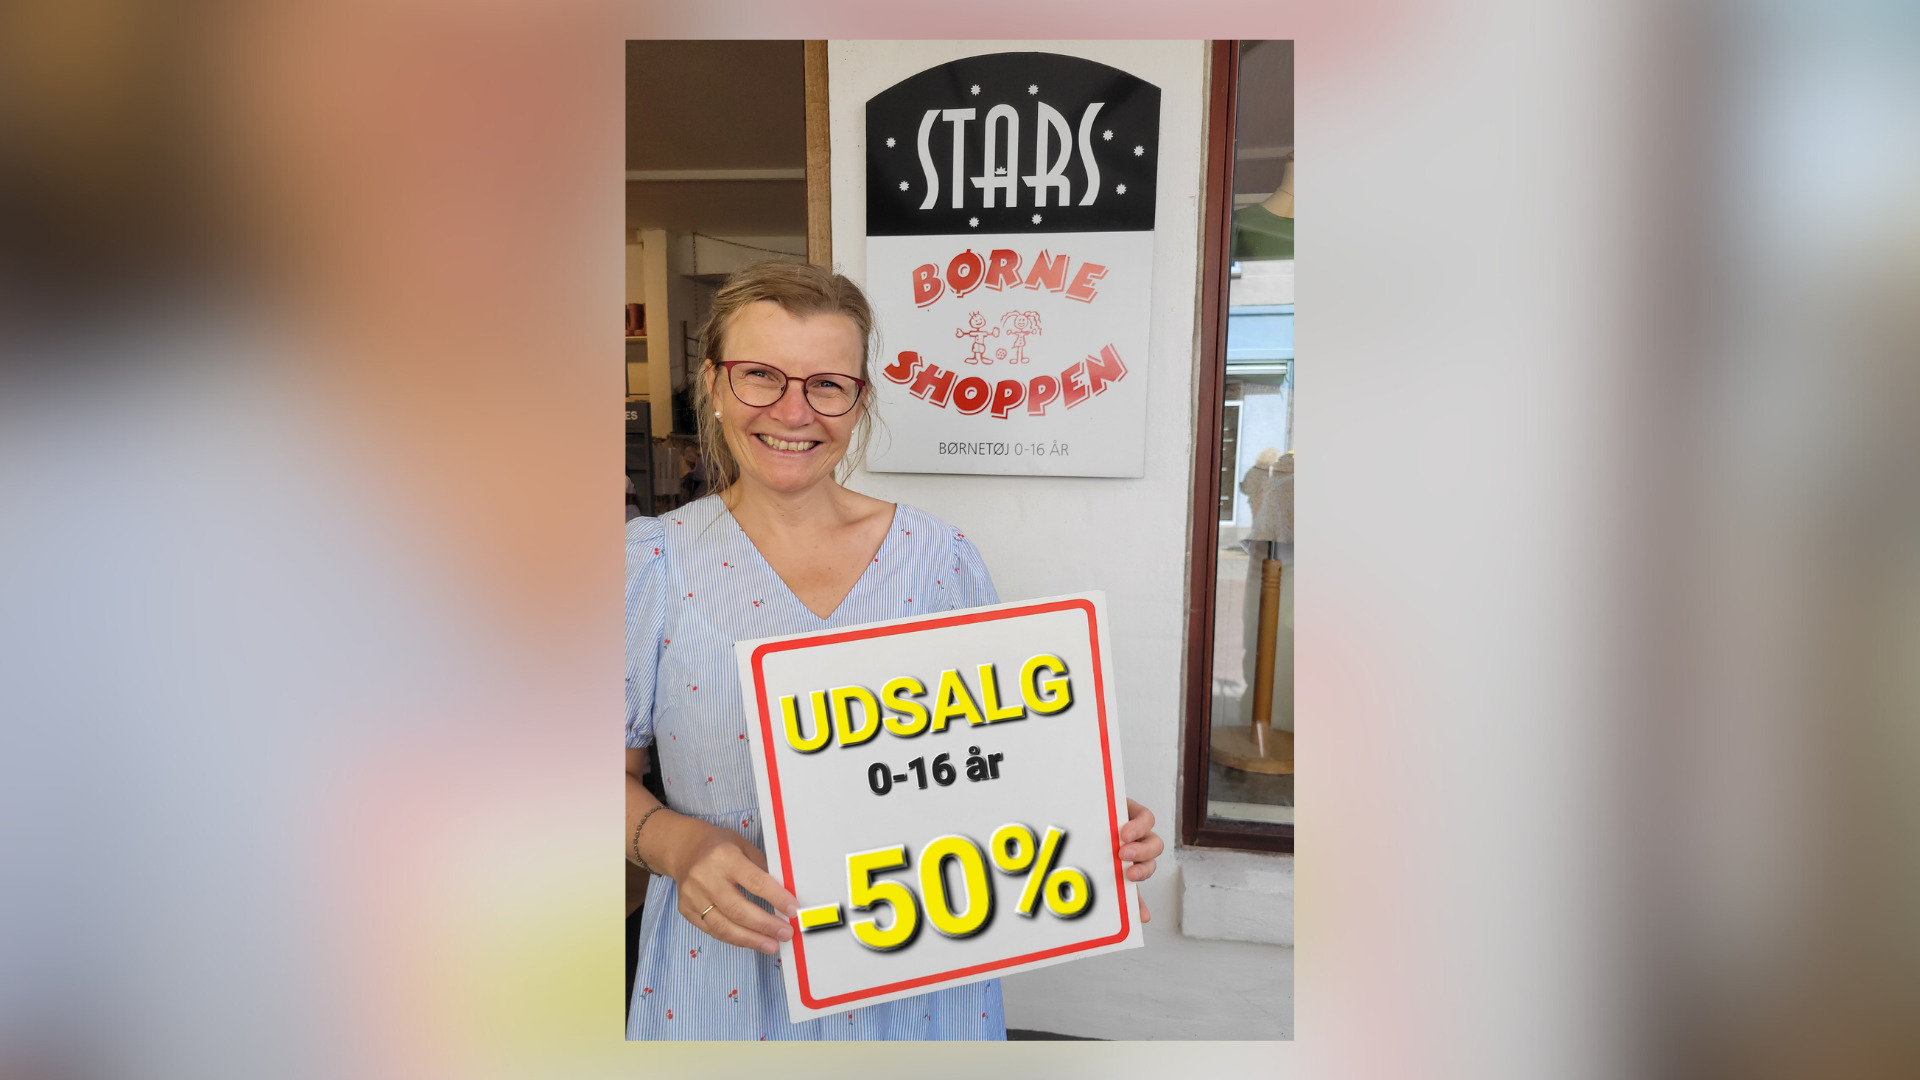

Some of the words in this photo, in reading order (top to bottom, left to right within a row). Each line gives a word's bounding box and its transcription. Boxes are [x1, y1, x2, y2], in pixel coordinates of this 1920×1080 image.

[917, 101, 1105, 210] STARS
[912, 248, 1109, 308] BØRNE
[883, 343, 1128, 420] SHOPPEN
[938, 441, 1010, 456] BØRNETØJ
[1014, 442, 1045, 456] 0-16
[1049, 439, 1069, 456] ÅR
